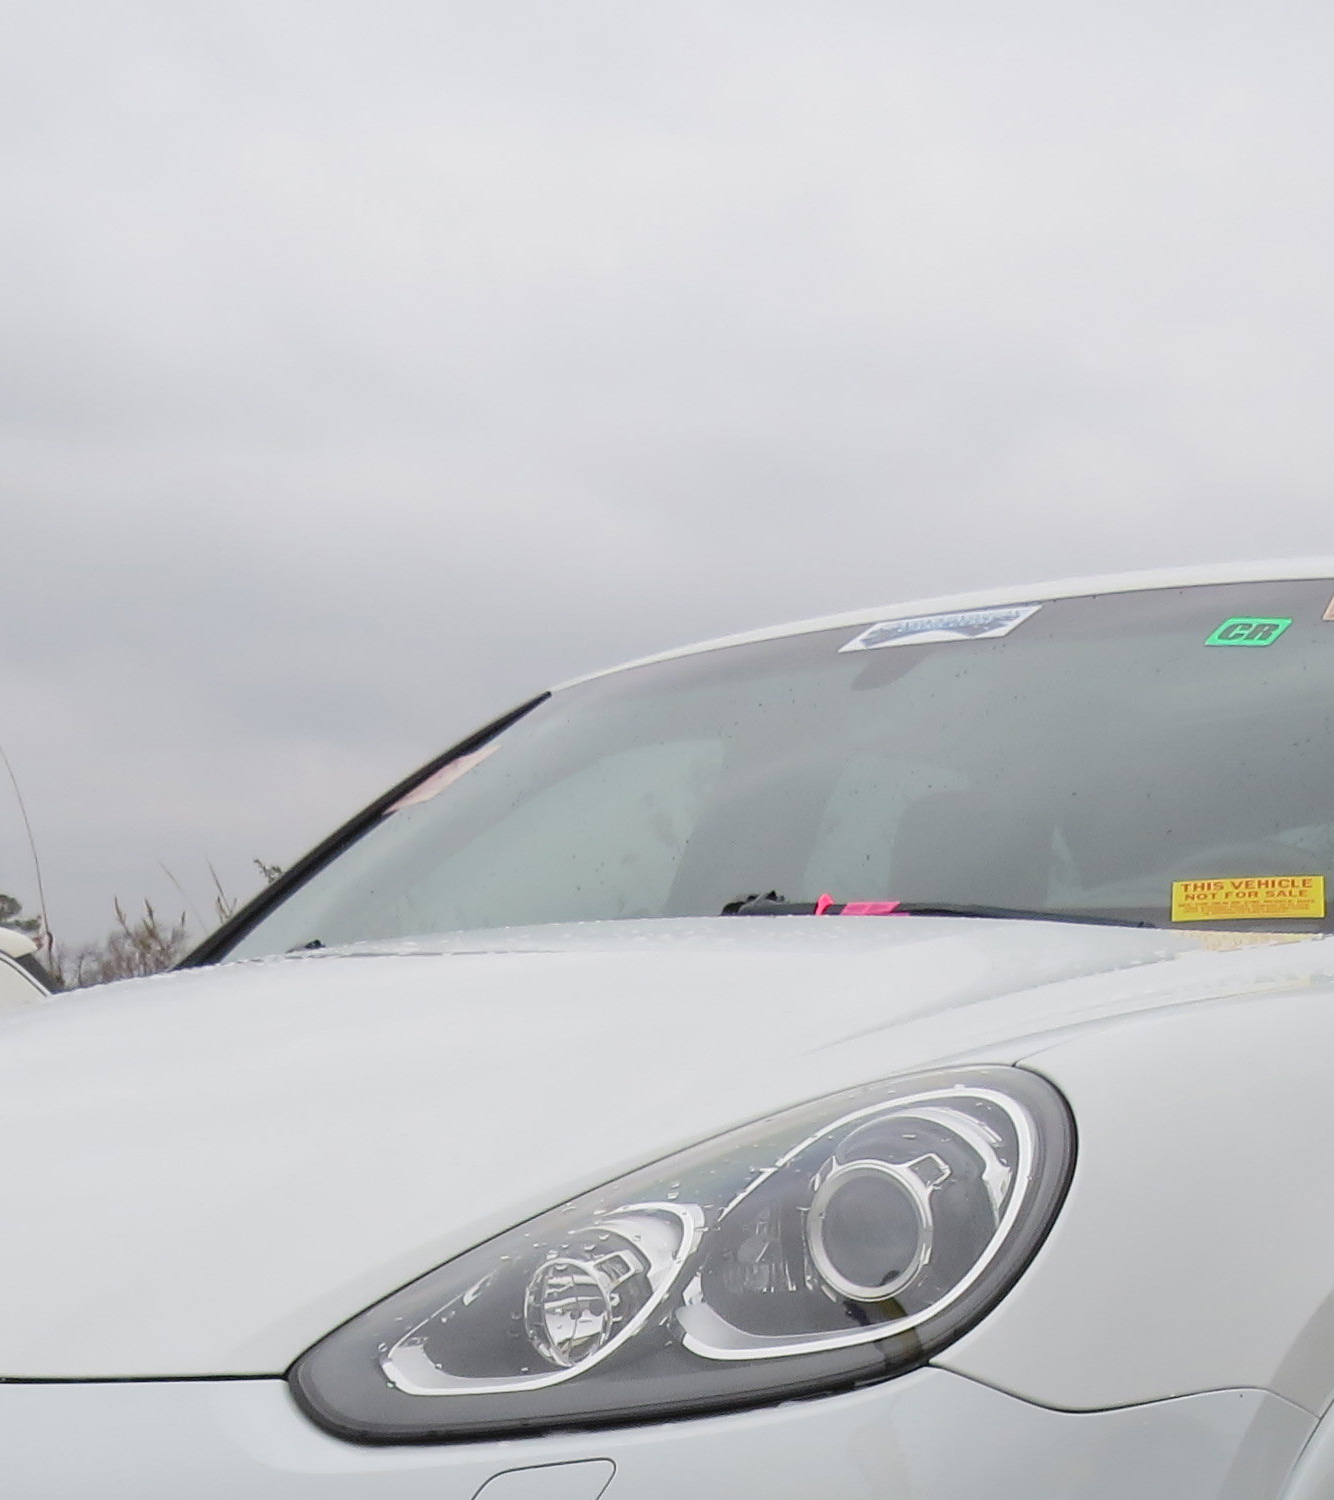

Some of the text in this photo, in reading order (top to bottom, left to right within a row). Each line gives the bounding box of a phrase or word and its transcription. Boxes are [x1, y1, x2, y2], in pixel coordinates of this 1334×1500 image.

[1217, 622, 1280, 641] CR
[1181, 879, 1313, 893] THIS VEHICLE
[1185, 889, 1307, 901] NOT FOR SALE
